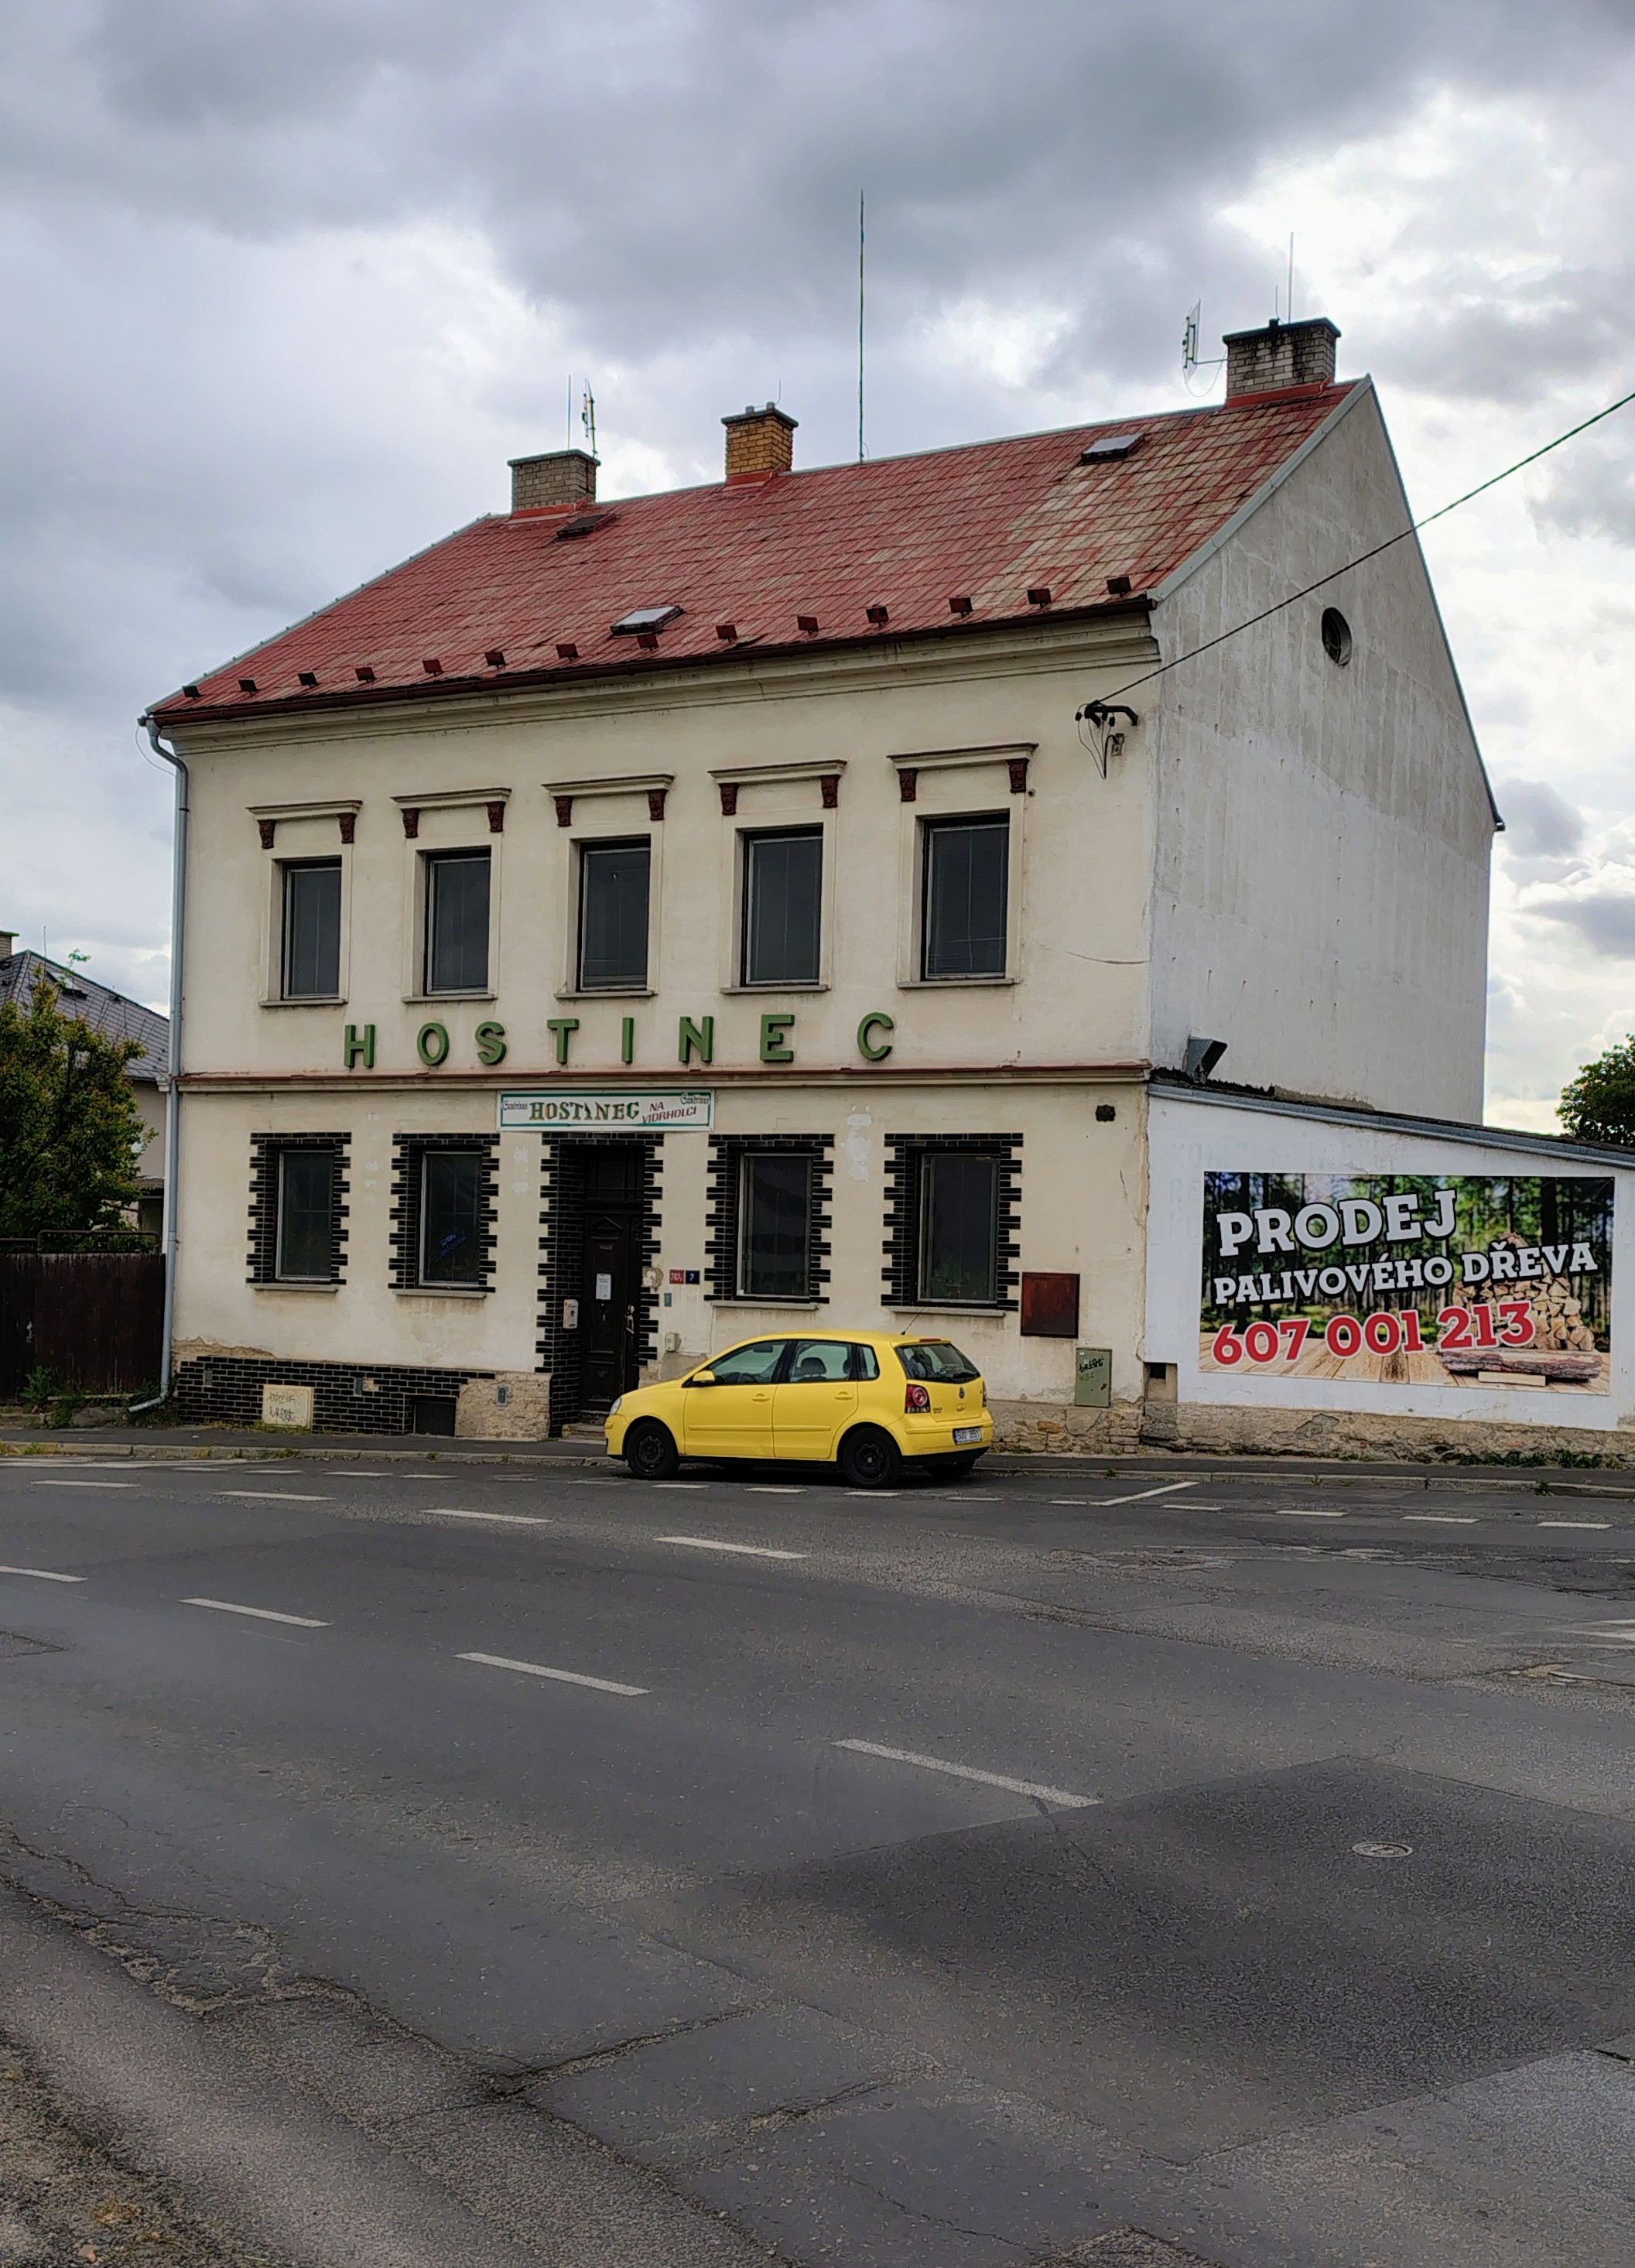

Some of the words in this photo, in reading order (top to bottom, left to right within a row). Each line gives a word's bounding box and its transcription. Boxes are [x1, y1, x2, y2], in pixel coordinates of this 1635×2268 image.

[344, 1012, 894, 1068] HOSTINEC
[528, 1101, 639, 1120] HOSTINEC
[641, 1106, 696, 1124] VIDRHOLCI
[649, 1101, 664, 1112] NA
[1216, 1189, 1457, 1257] PRODEJ
[1213, 1252, 1453, 1305] PALIVOVÉHO
[1461, 1240, 1599, 1282] DŘEVA
[1212, 1318, 1311, 1367] 607
[1324, 1309, 1425, 1359] 001
[1436, 1299, 1536, 1352] 213
